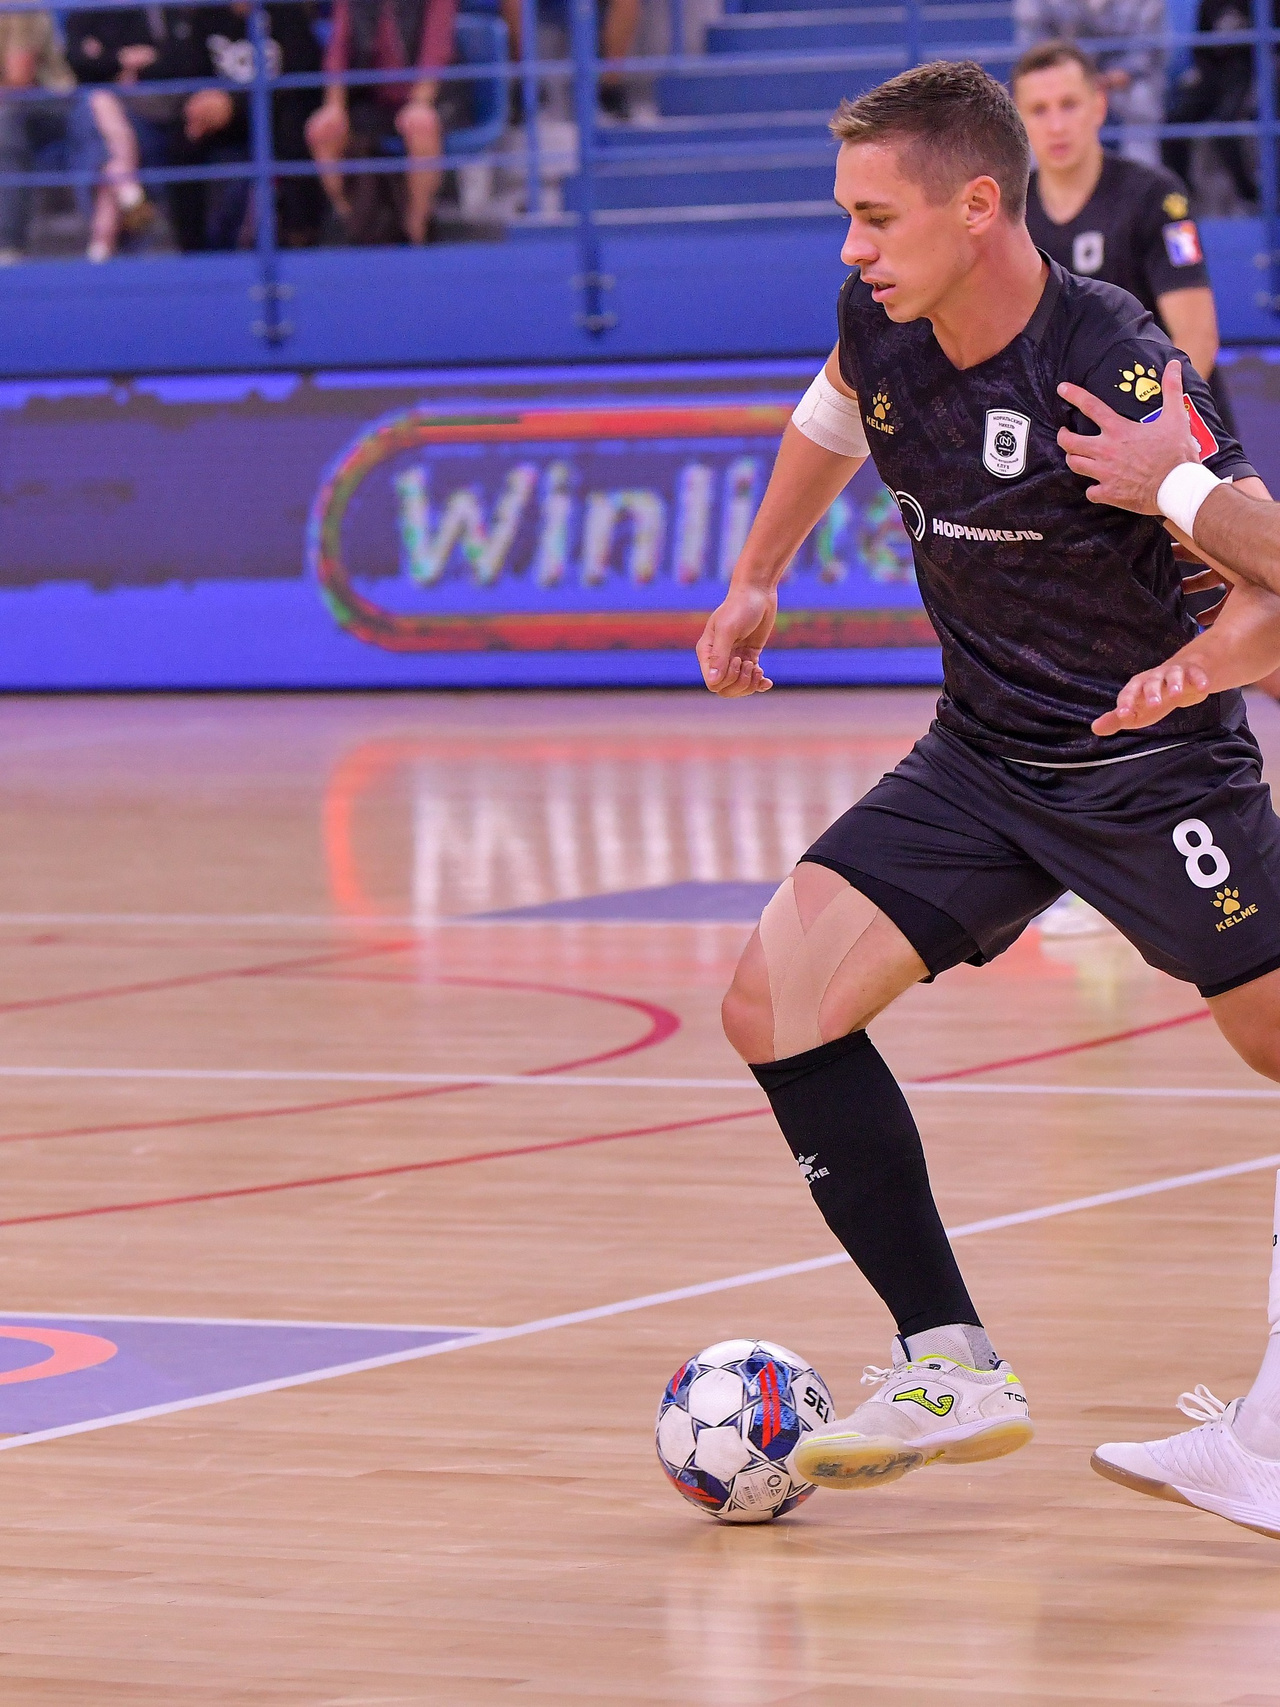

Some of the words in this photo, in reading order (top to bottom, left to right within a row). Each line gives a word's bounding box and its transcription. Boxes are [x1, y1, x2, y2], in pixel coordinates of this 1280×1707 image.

[1139, 384, 1159, 398] KELME
[866, 415, 895, 435] KELME
[932, 517, 1044, 542] НОРНИКЕЛЬ
[1172, 818, 1231, 889] 8
[1215, 903, 1259, 932] KELME
[805, 1166, 831, 1184] LME
[803, 1386, 830, 1424] SEL
